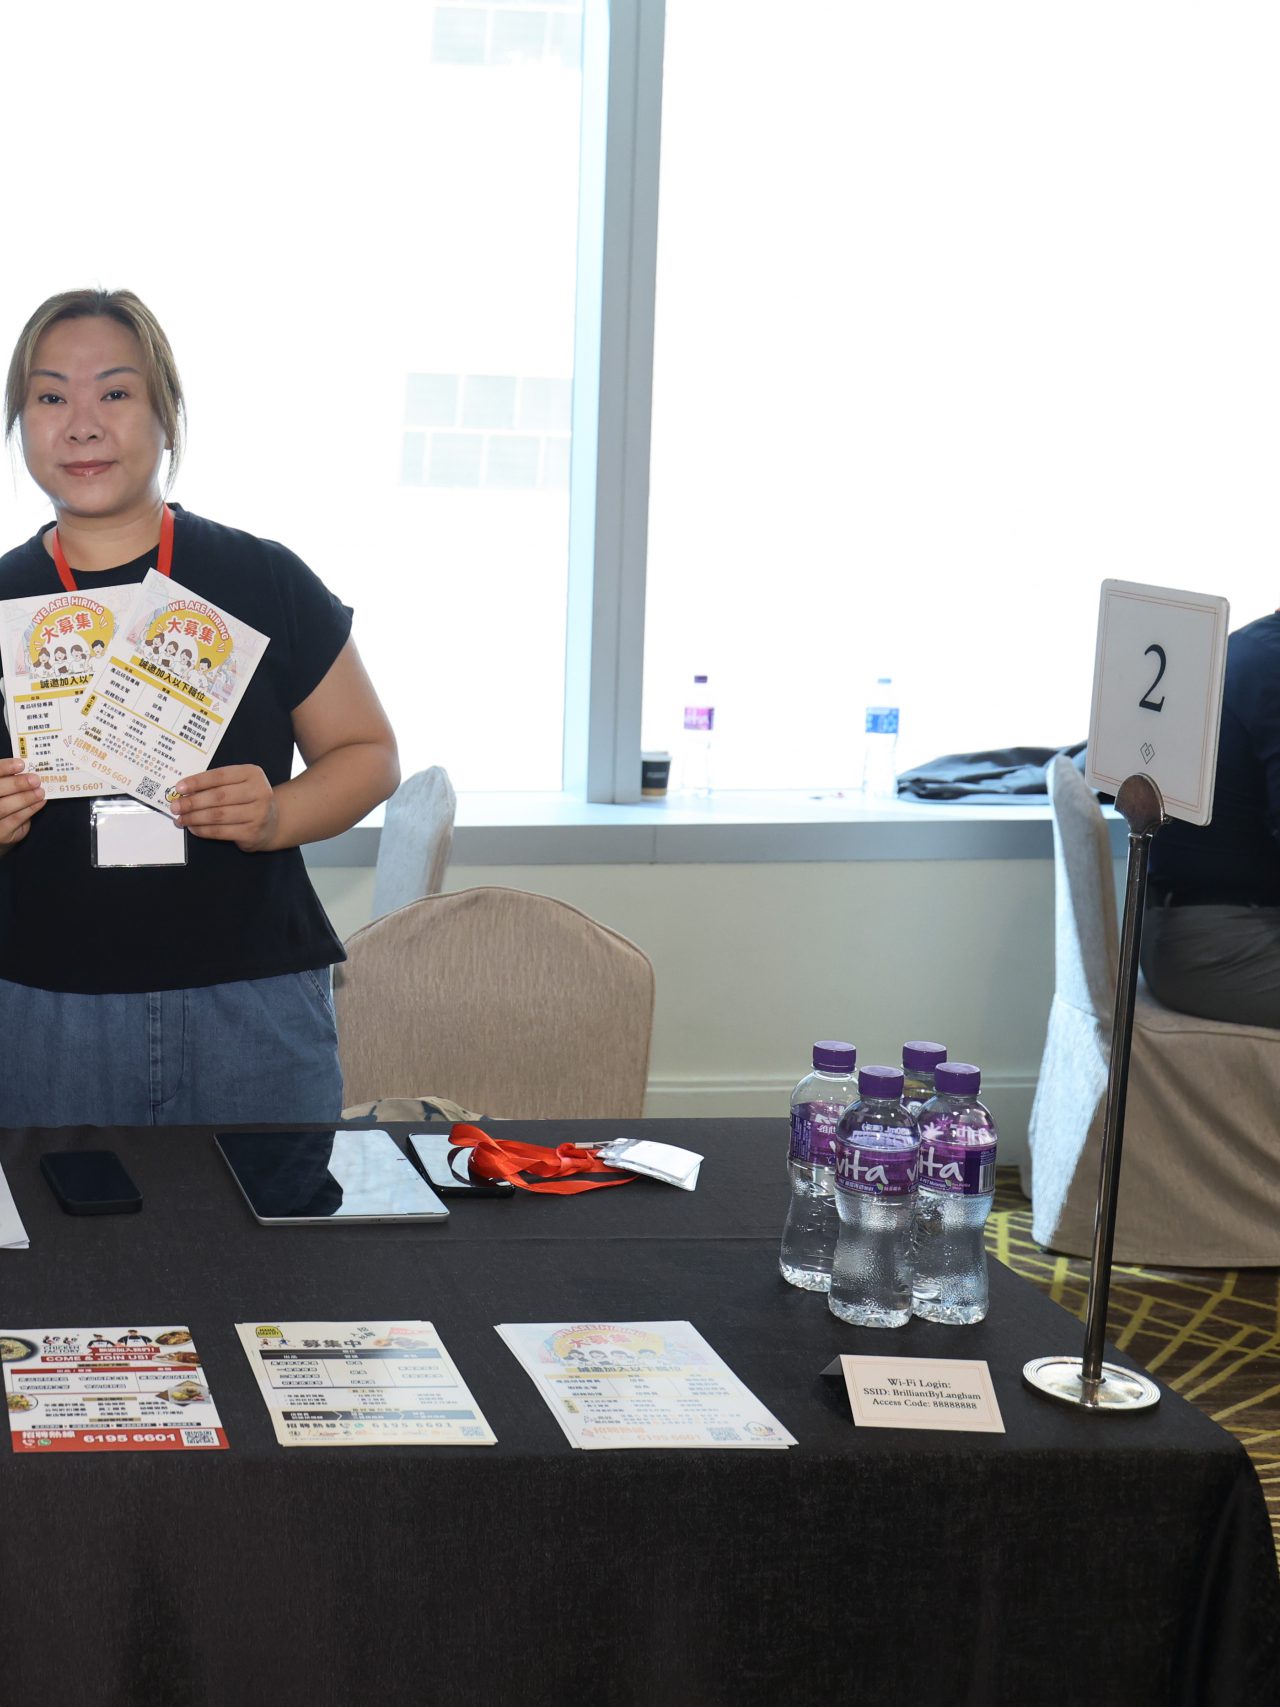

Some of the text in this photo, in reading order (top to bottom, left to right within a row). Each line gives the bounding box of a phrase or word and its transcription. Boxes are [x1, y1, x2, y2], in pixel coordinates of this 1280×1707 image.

[32, 596, 105, 624] WE ARE HIRING
[168, 600, 229, 641] WE ARE HIRING
[42, 612, 92, 644] 大募集
[168, 618, 215, 645] 大募集
[40, 674, 94, 689] 誠邀加入以
[138, 657, 206, 702] 誠邀加入以下職位
[1139, 643, 1167, 713] 2
[91, 761, 111, 776] 6195
[111, 771, 132, 787] 6601
[59, 782, 104, 793] 6195 6601
[920, 1147, 963, 1181] ita
[863, 1388, 981, 1400] SSID: BrilliantByLangham
[888, 1378, 951, 1389] Wi-Fi Login:
[872, 1398, 977, 1409] Access Code: 88888888
[82, 1433, 177, 1443] 6195 6601
